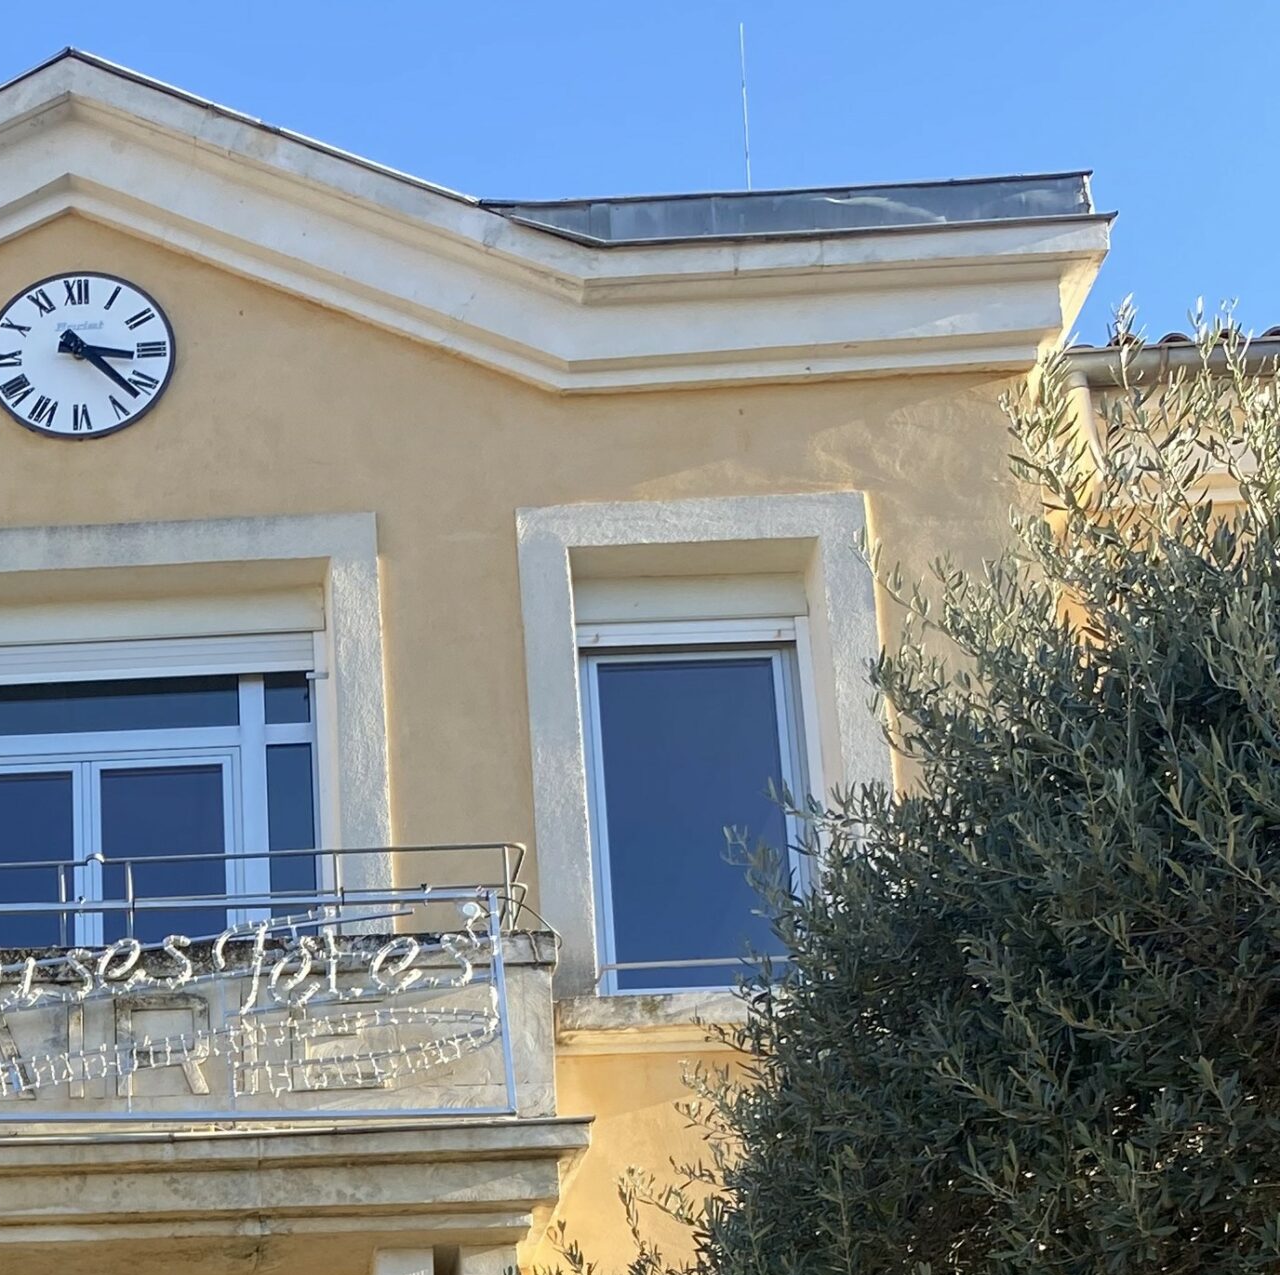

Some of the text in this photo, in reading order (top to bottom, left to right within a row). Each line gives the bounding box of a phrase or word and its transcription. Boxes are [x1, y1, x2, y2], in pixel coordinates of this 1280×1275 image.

[27, 288, 57, 318] XI
[63, 279, 90, 306] XII
[104, 286, 122, 311] I
[0, 317, 32, 338] X
[124, 307, 156, 330] II
[136, 341, 167, 358] III
[127, 369, 160, 396] IV
[27, 395, 59, 428] VII
[72, 403, 93, 431] VI
[108, 394, 131, 421] V
